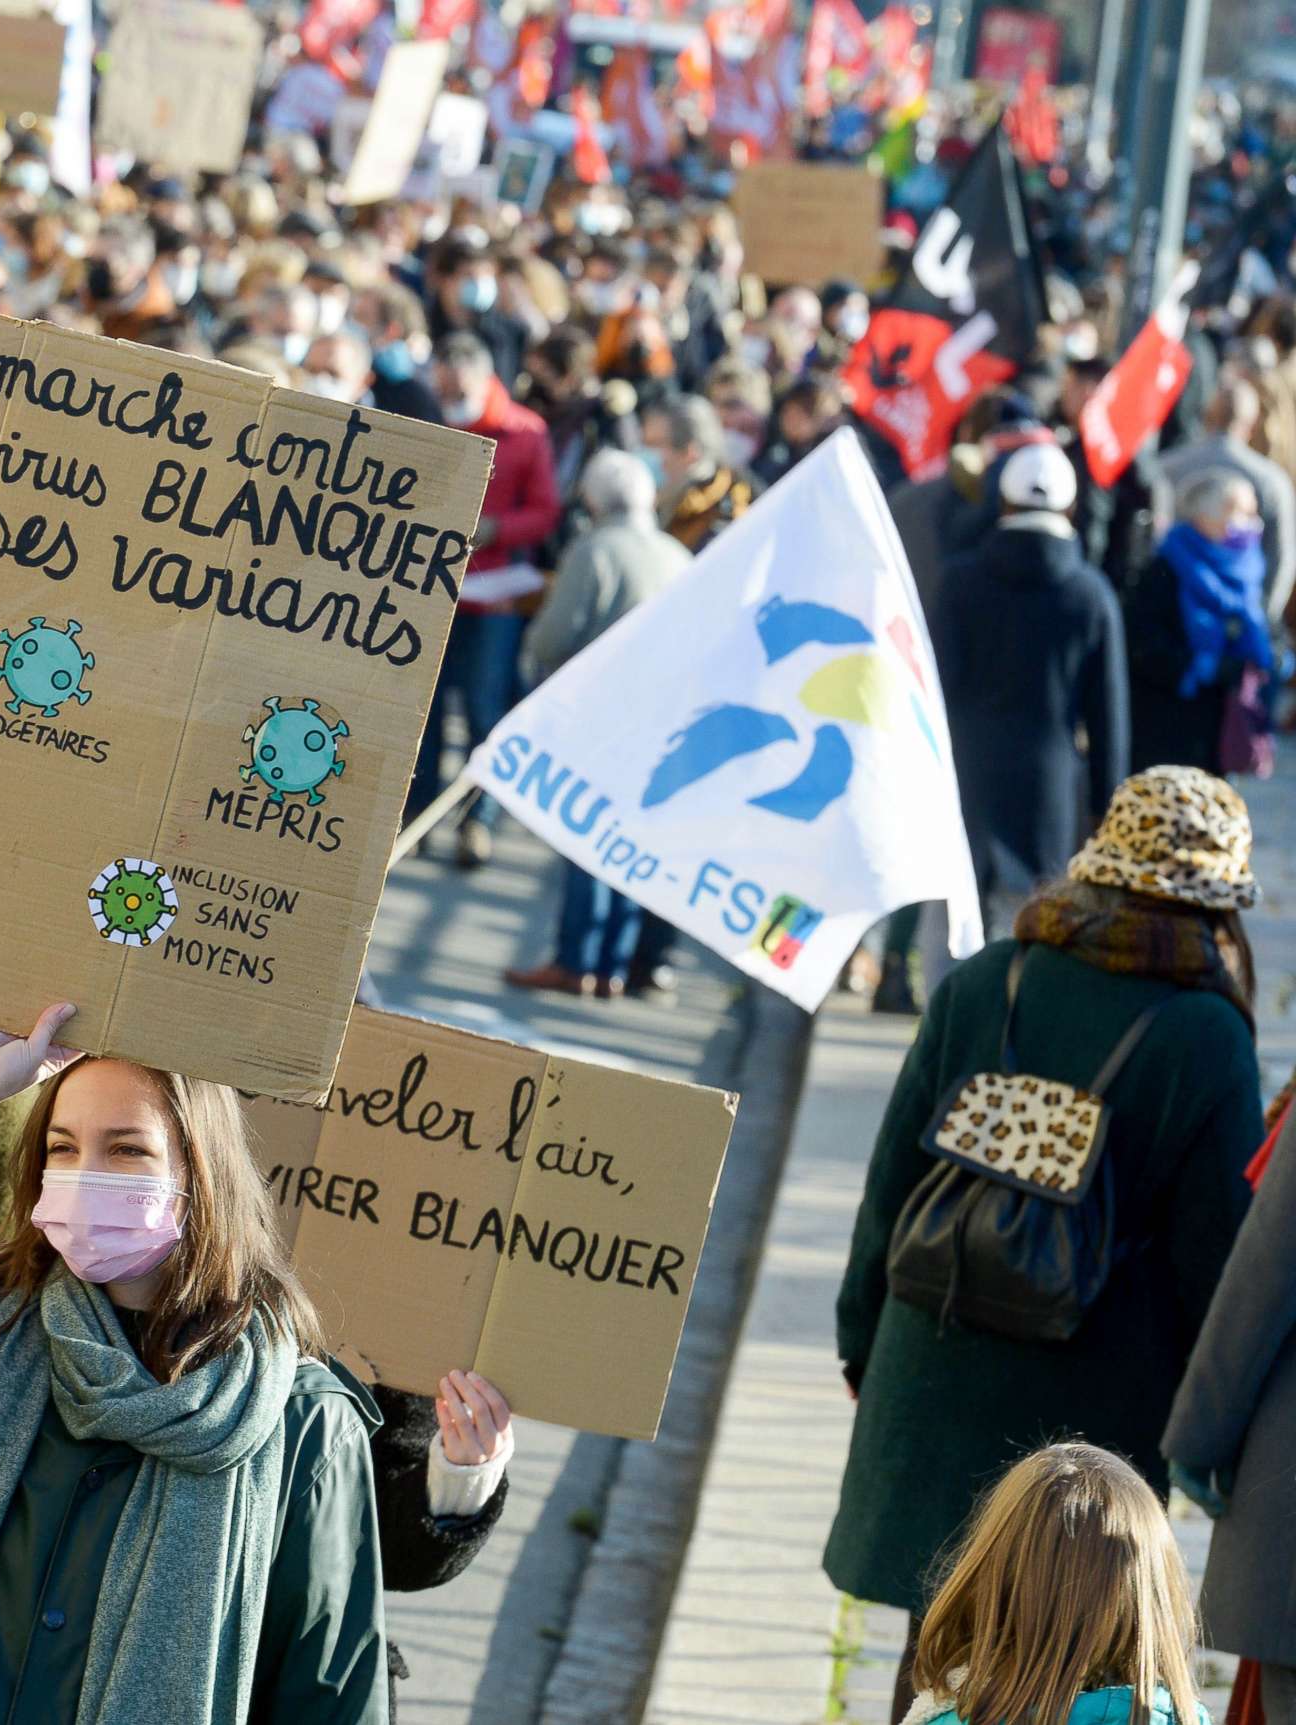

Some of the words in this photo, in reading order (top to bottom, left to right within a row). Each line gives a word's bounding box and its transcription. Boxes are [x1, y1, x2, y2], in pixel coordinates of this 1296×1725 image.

[226, 408, 418, 511] contre
[141, 459, 468, 602] BLANQUER
[112, 534, 422, 666] variants
[205, 785, 345, 852] MÉPRIS
[172, 864, 300, 914] INCLUSION
[194, 902, 271, 940] SANS
[162, 934, 275, 984] MOYENS
[408, 1191, 685, 1296] BLANQUER
